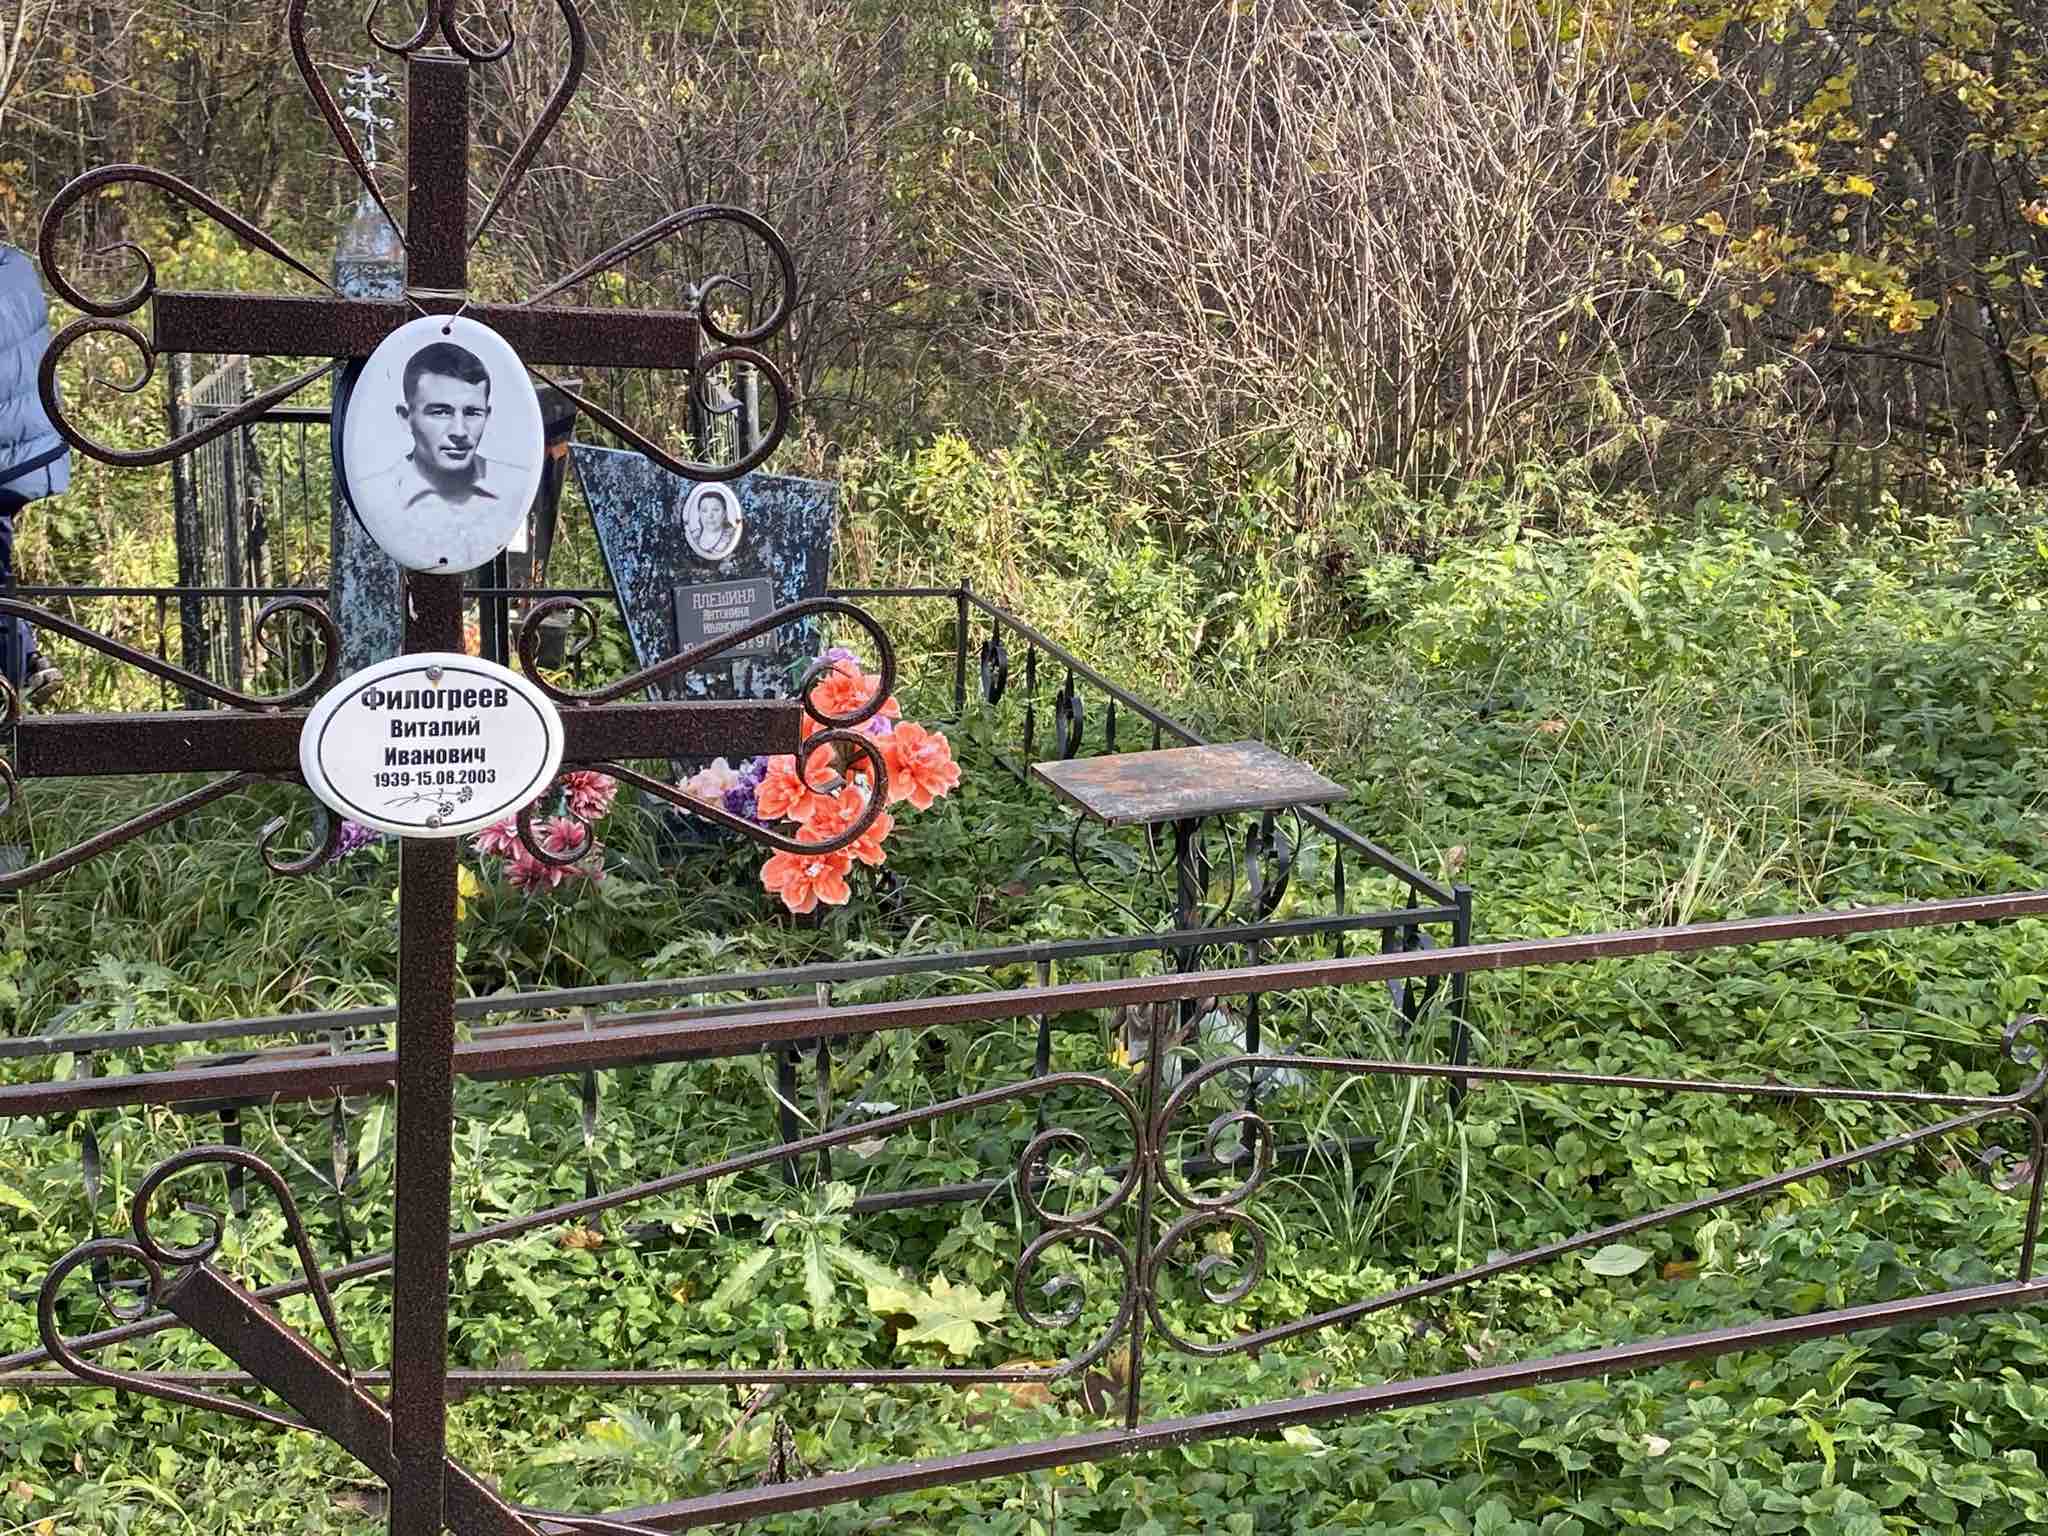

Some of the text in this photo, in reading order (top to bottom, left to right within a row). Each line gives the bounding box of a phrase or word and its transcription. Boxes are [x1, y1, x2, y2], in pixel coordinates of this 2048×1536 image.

[692, 588, 755, 609] АЛЕШИНА
[361, 687, 508, 711] Филогреев
[391, 715, 480, 738] Виталий
[384, 747, 486, 766] Иванович
[373, 769, 496, 787] 1939-15.08.2003
